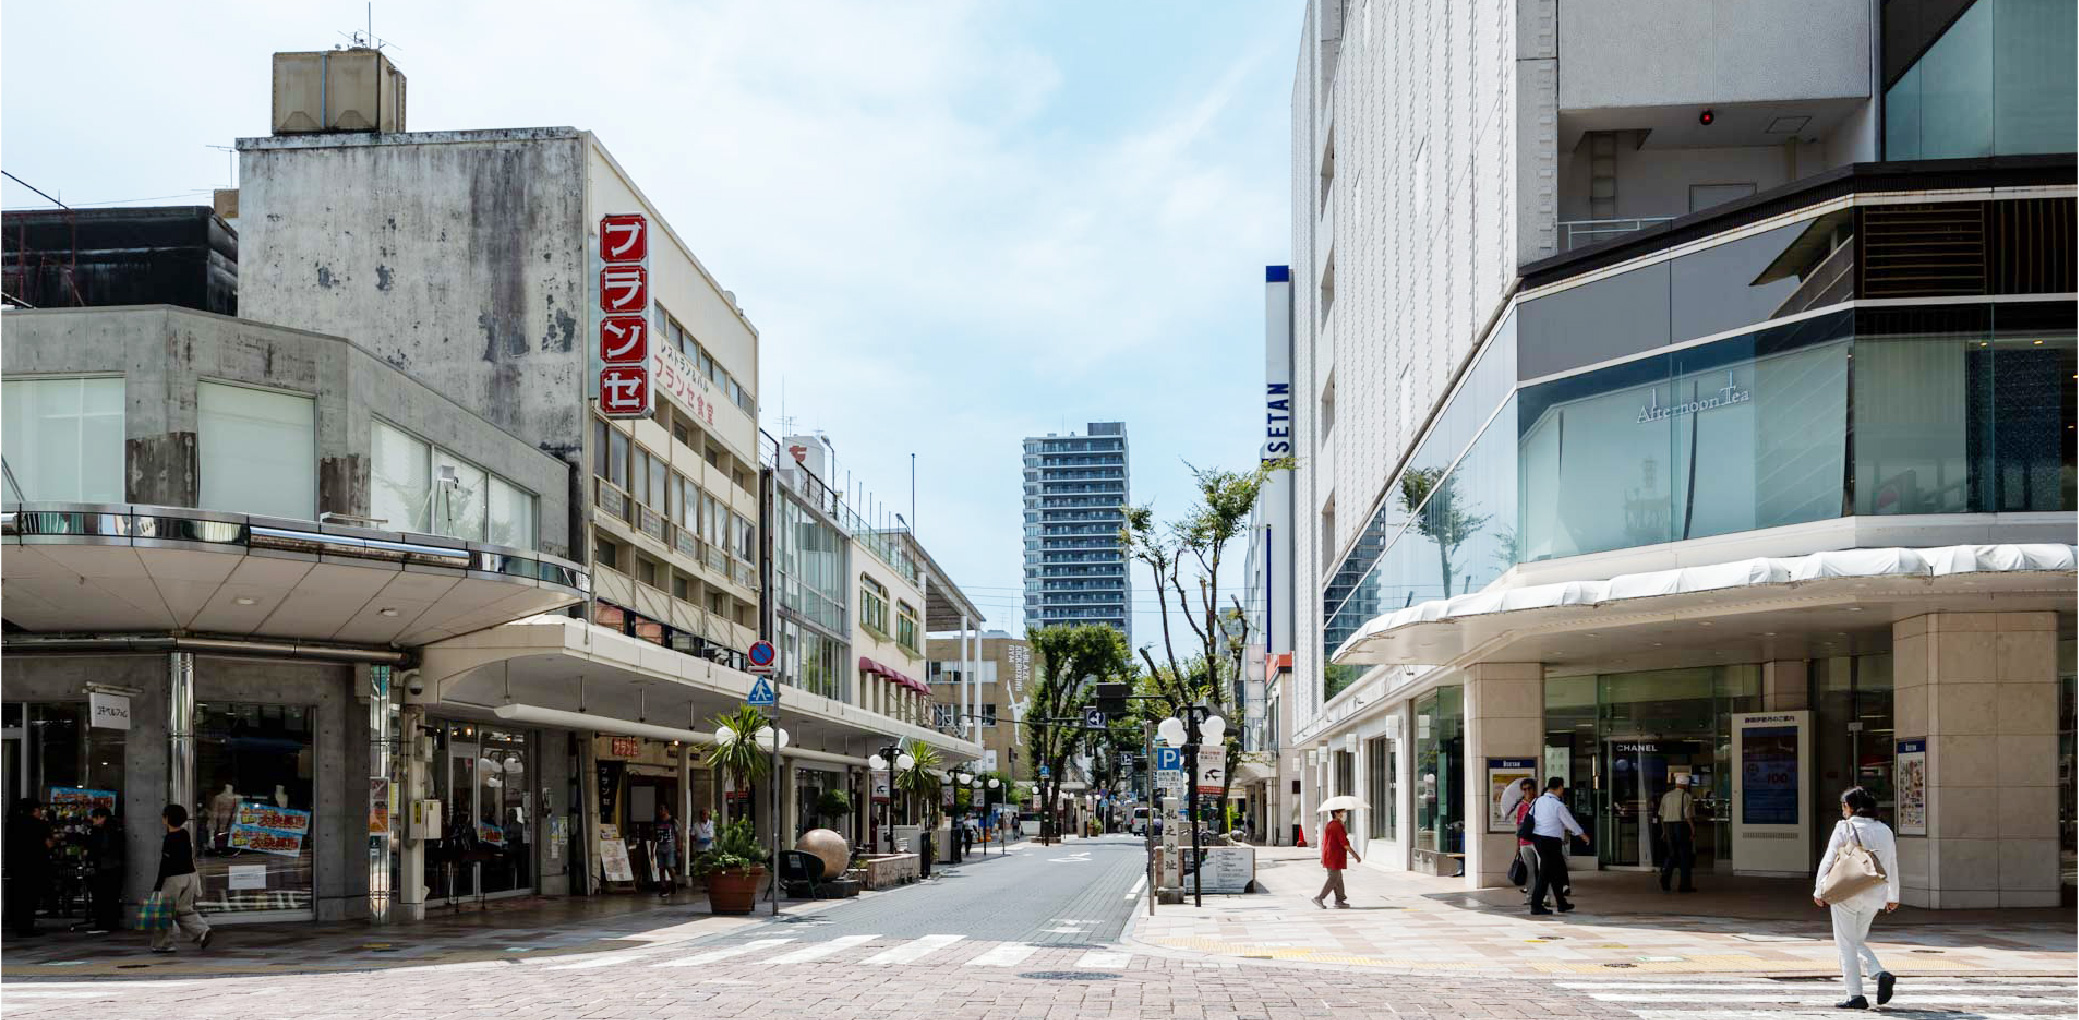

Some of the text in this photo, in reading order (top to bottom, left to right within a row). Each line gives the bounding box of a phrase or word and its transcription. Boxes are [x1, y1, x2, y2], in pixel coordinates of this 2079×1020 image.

[604, 221, 642, 410] フランセ
[654, 354, 713, 426] フランセ食堂
[1637, 387, 1719, 424] Afternoon
[1015, 645, 1023, 691] KICKBOXING
[613, 739, 639, 755] フランセ
[1163, 749, 1177, 768] P
[1616, 744, 1659, 752] CHANEL
[600, 766, 611, 806] フランセ
